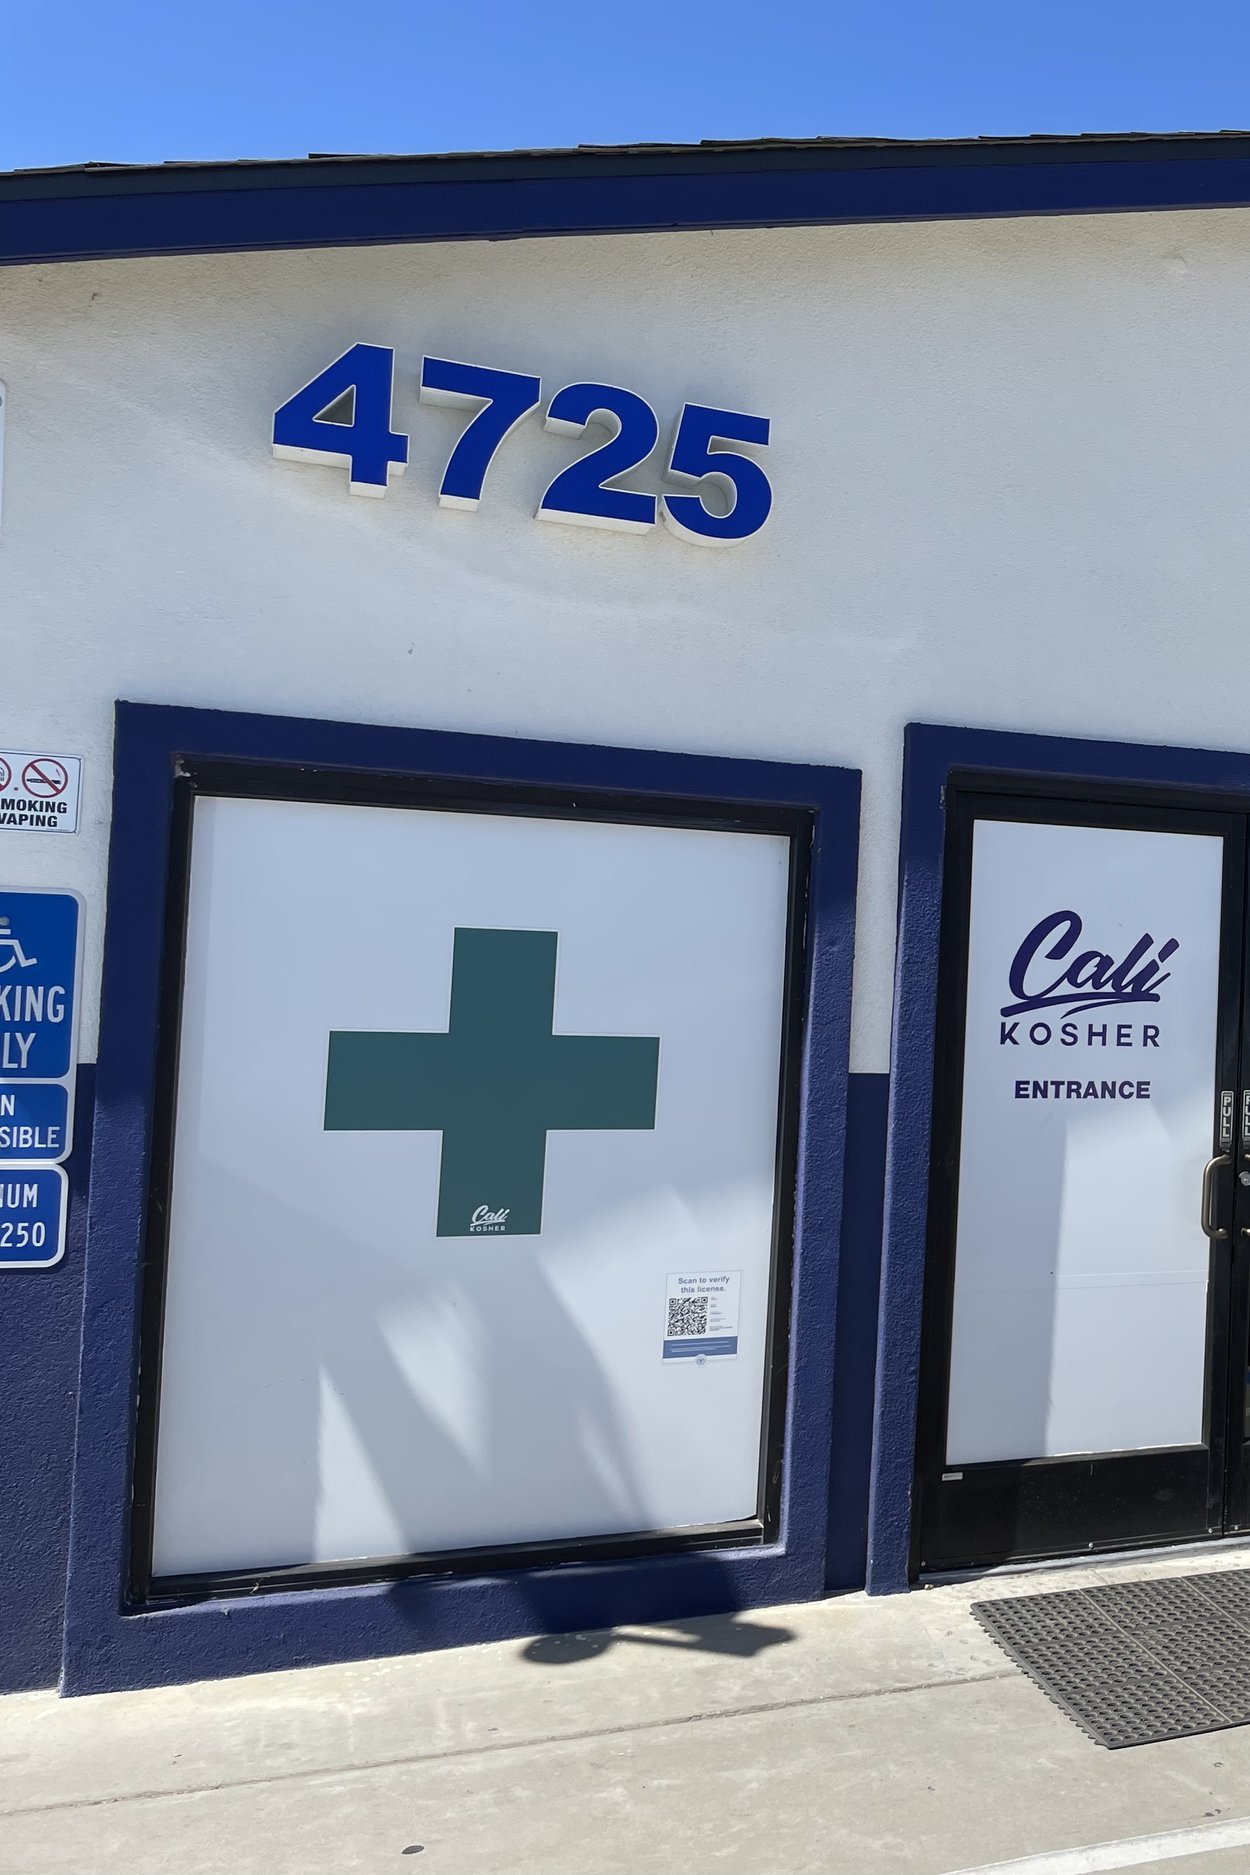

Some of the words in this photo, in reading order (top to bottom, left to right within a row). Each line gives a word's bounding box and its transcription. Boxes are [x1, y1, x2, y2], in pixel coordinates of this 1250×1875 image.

[272, 342, 774, 547] 4725
[1000, 910, 1180, 1019] Cali
[1000, 1021, 1161, 1048] KOSHER
[1014, 1080, 1151, 1099] ENTRANCE
[1222, 1096, 1232, 1138] PULL
[0, 1183, 38, 1208] UM
[469, 1204, 511, 1227] Cali
[709, 1275, 730, 1284] verify
